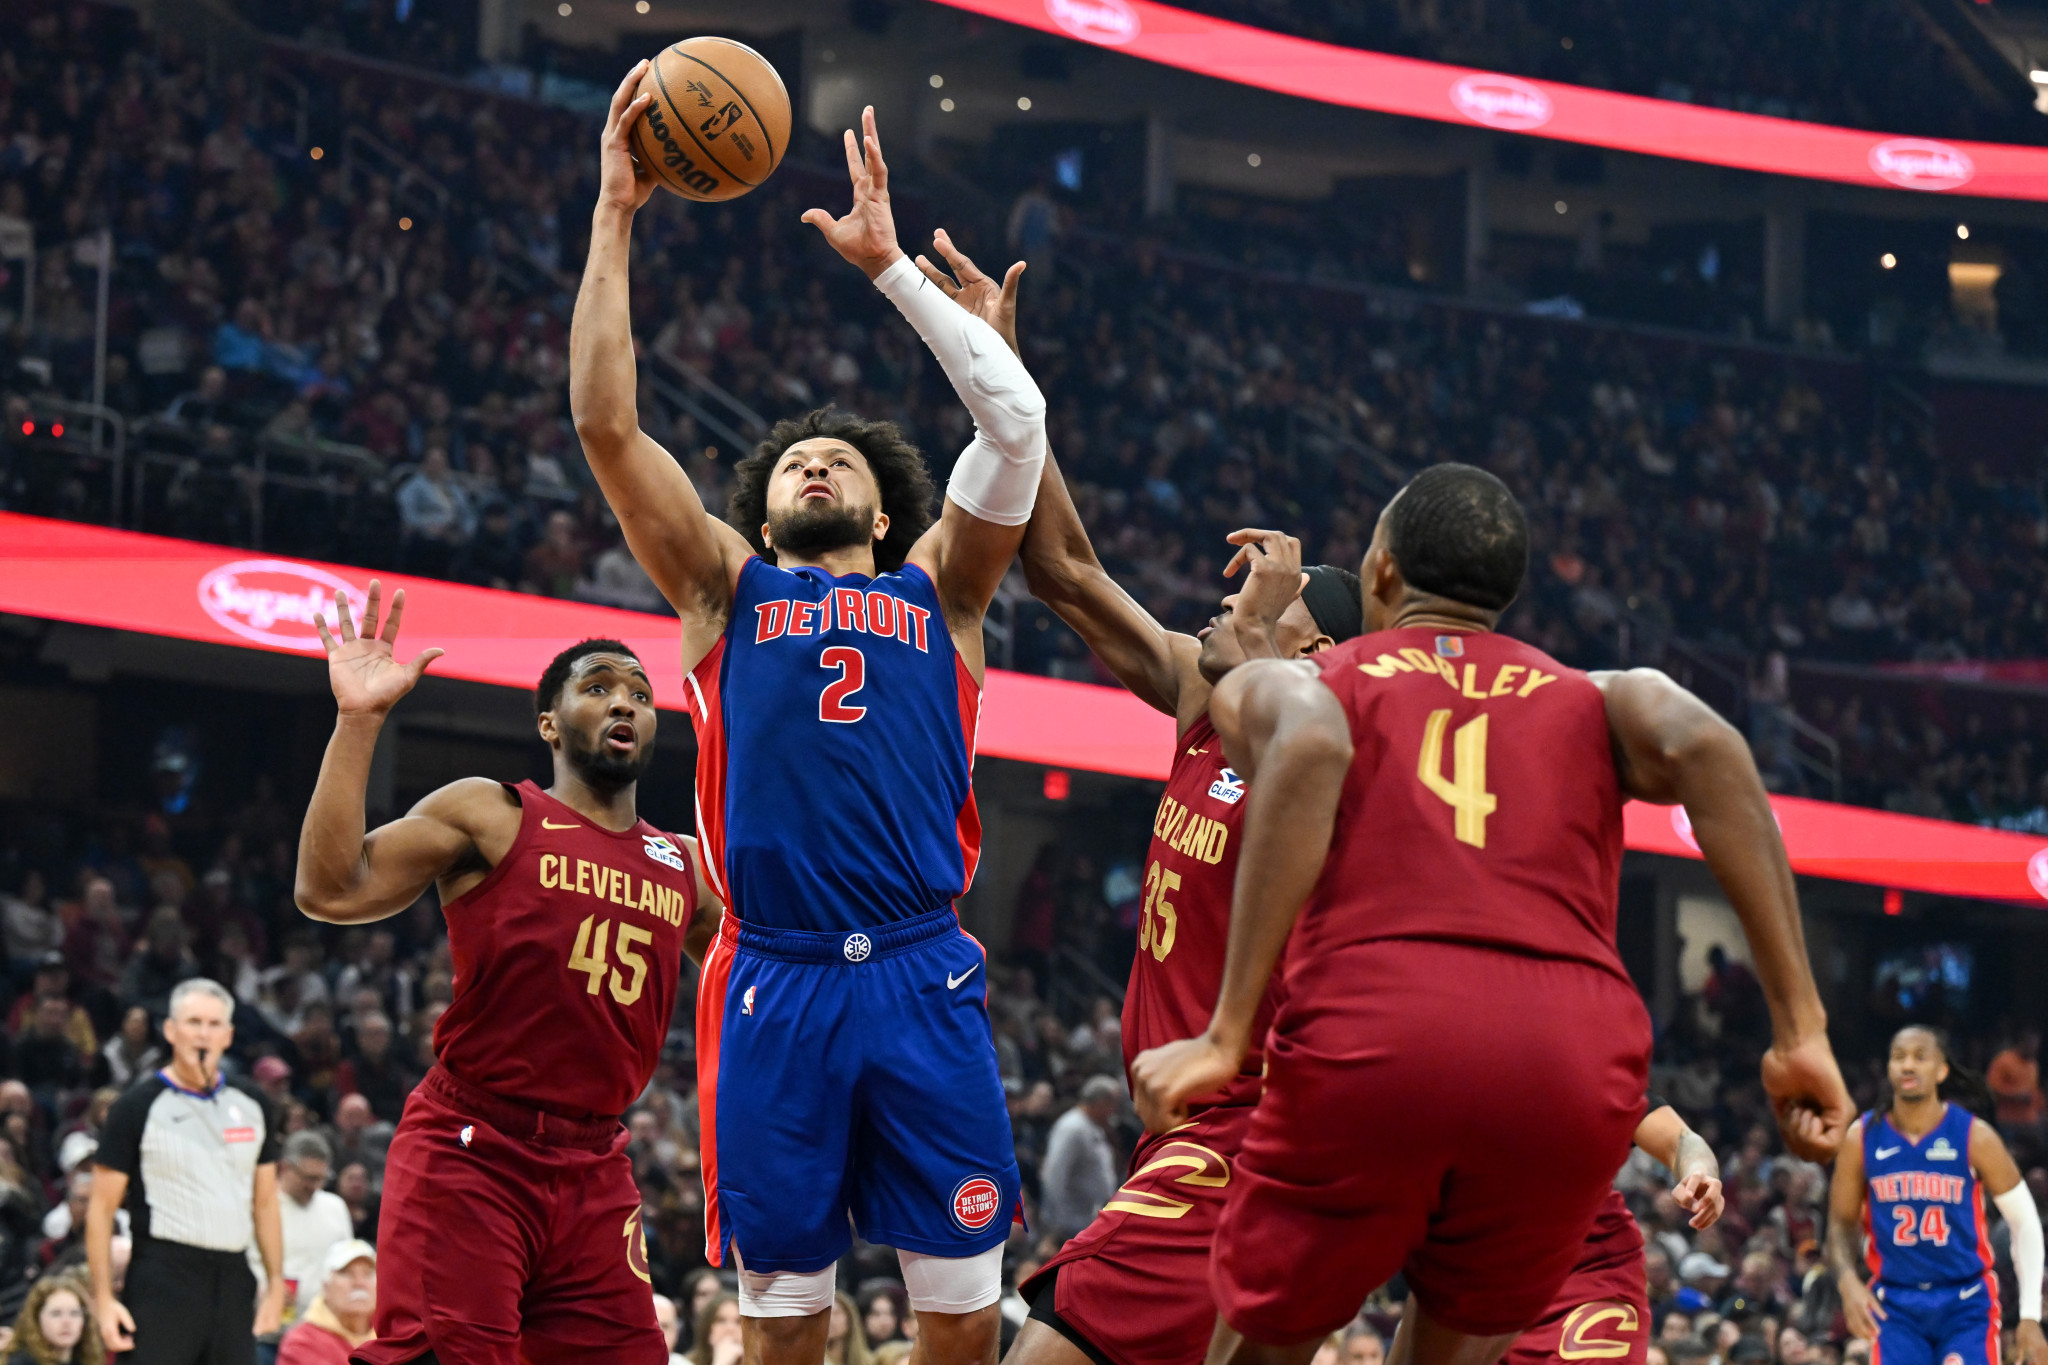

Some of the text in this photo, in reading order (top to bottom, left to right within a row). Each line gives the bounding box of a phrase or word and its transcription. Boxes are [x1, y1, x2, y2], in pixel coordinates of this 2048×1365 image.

[646, 100, 719, 194] Wilson
[754, 587, 931, 654] DETROIT
[818, 645, 867, 723] 2
[1357, 647, 1559, 699] MOBLEY
[1211, 783, 1241, 801] CLIFFS
[1417, 709, 1498, 849] 4
[646, 848, 682, 868] CLIFFS
[539, 853, 686, 928] CLEVELAND
[1140, 860, 1182, 963] 35
[568, 913, 653, 1006] 45
[961, 1190, 993, 1206] DETROIT
[962, 1199, 994, 1215] PISTONS
[1870, 1171, 1966, 1205] DETROIT
[1892, 1204, 1951, 1247] 24
